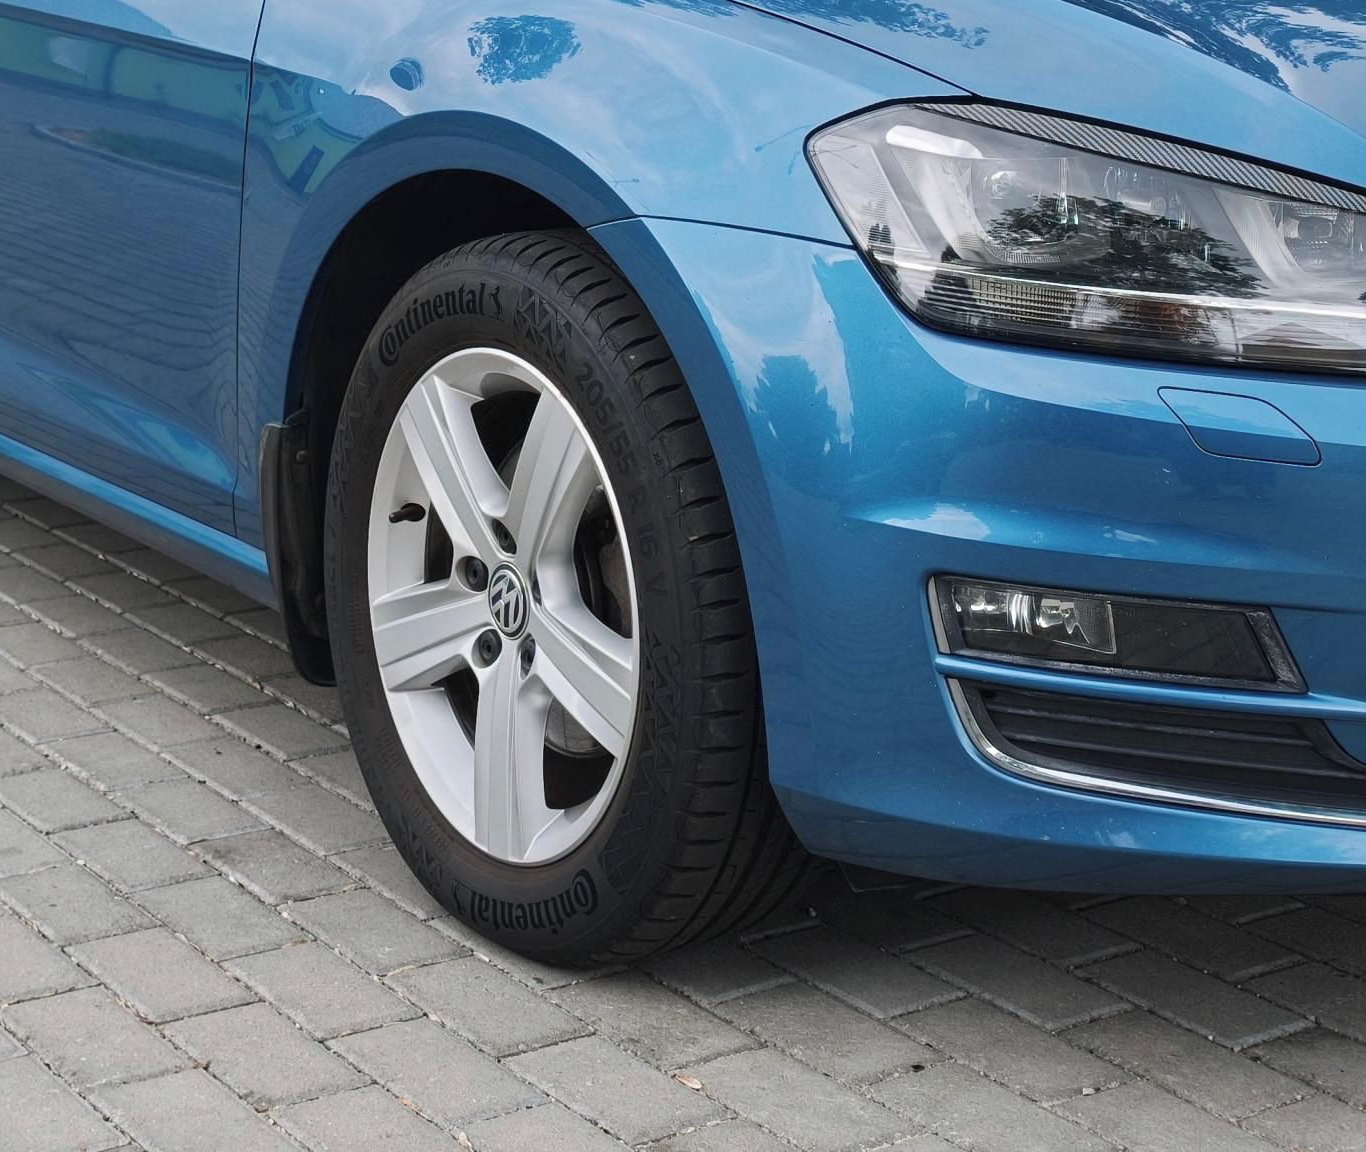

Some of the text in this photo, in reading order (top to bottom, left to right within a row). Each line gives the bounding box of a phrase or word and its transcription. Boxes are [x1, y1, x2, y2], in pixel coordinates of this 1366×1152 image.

[378, 282, 486, 367] Continental
[574, 360, 638, 477] 205/55
[469, 868, 600, 935] Continental
